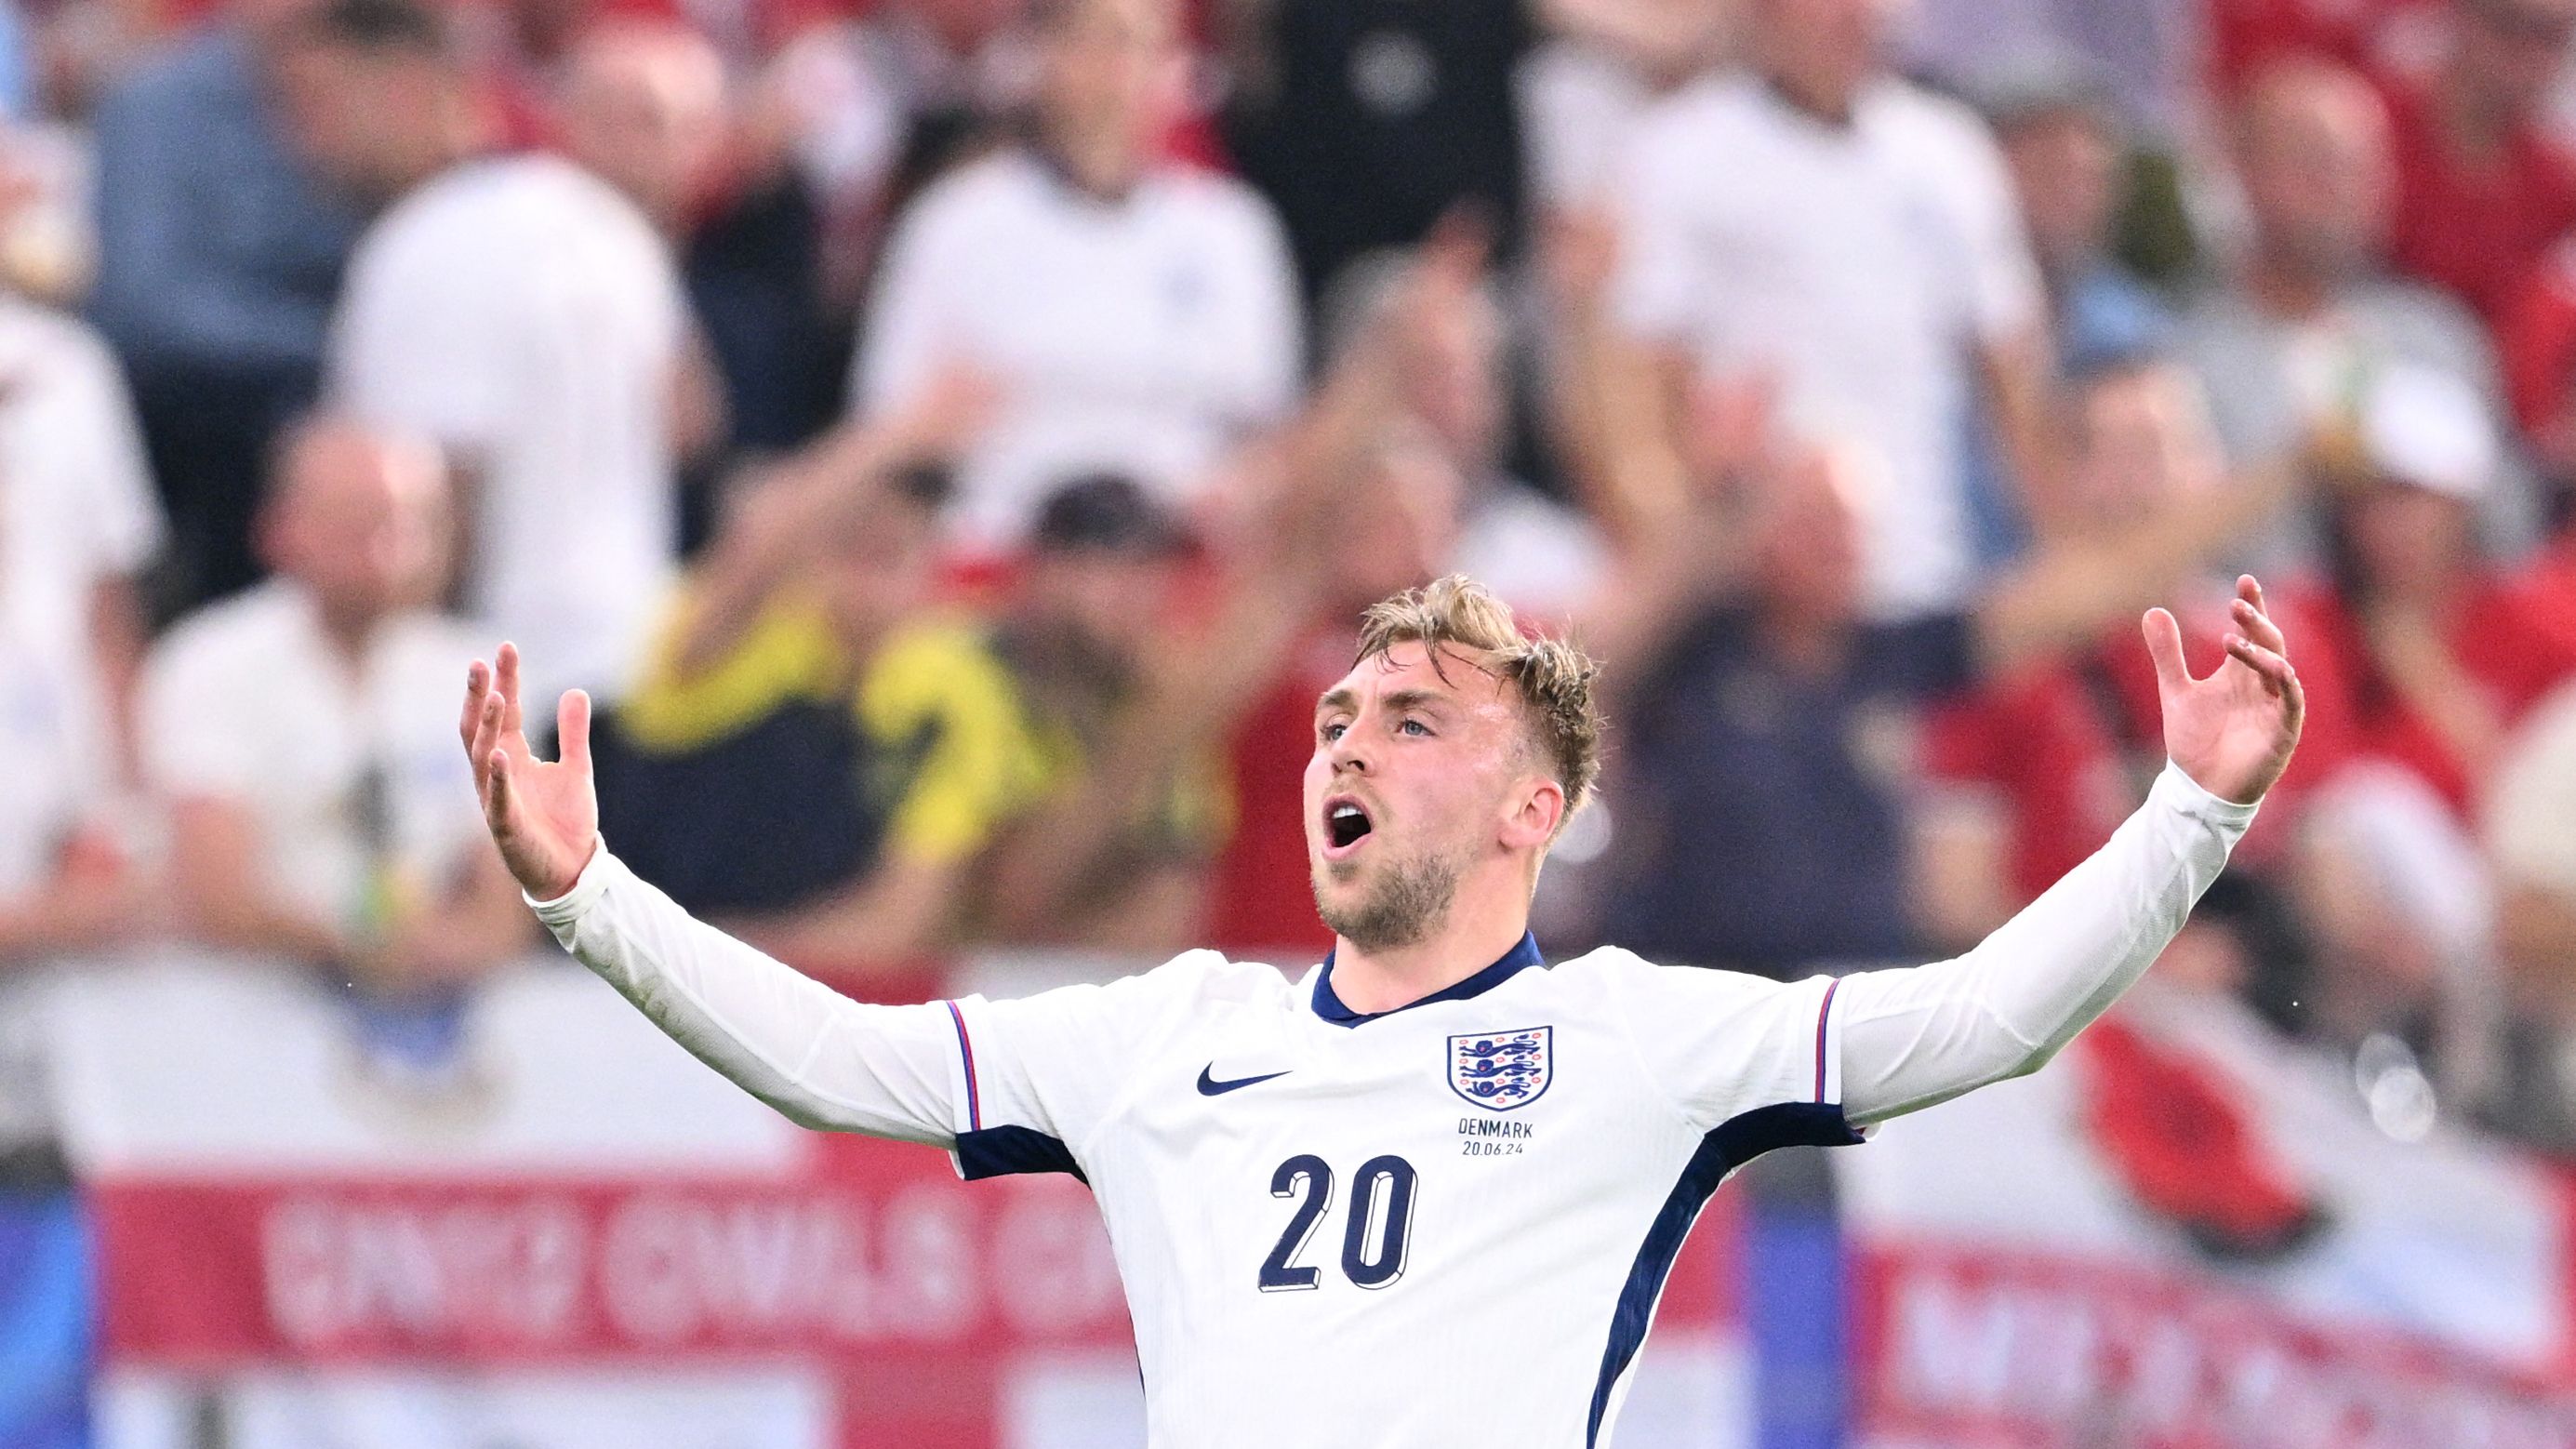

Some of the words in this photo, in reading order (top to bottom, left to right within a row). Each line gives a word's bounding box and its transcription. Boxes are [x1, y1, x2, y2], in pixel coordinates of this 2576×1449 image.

[1458, 1118, 1534, 1138] DENMARK
[1462, 1140, 1523, 1156] 20.06.24
[1257, 1154, 1419, 1294] 20
